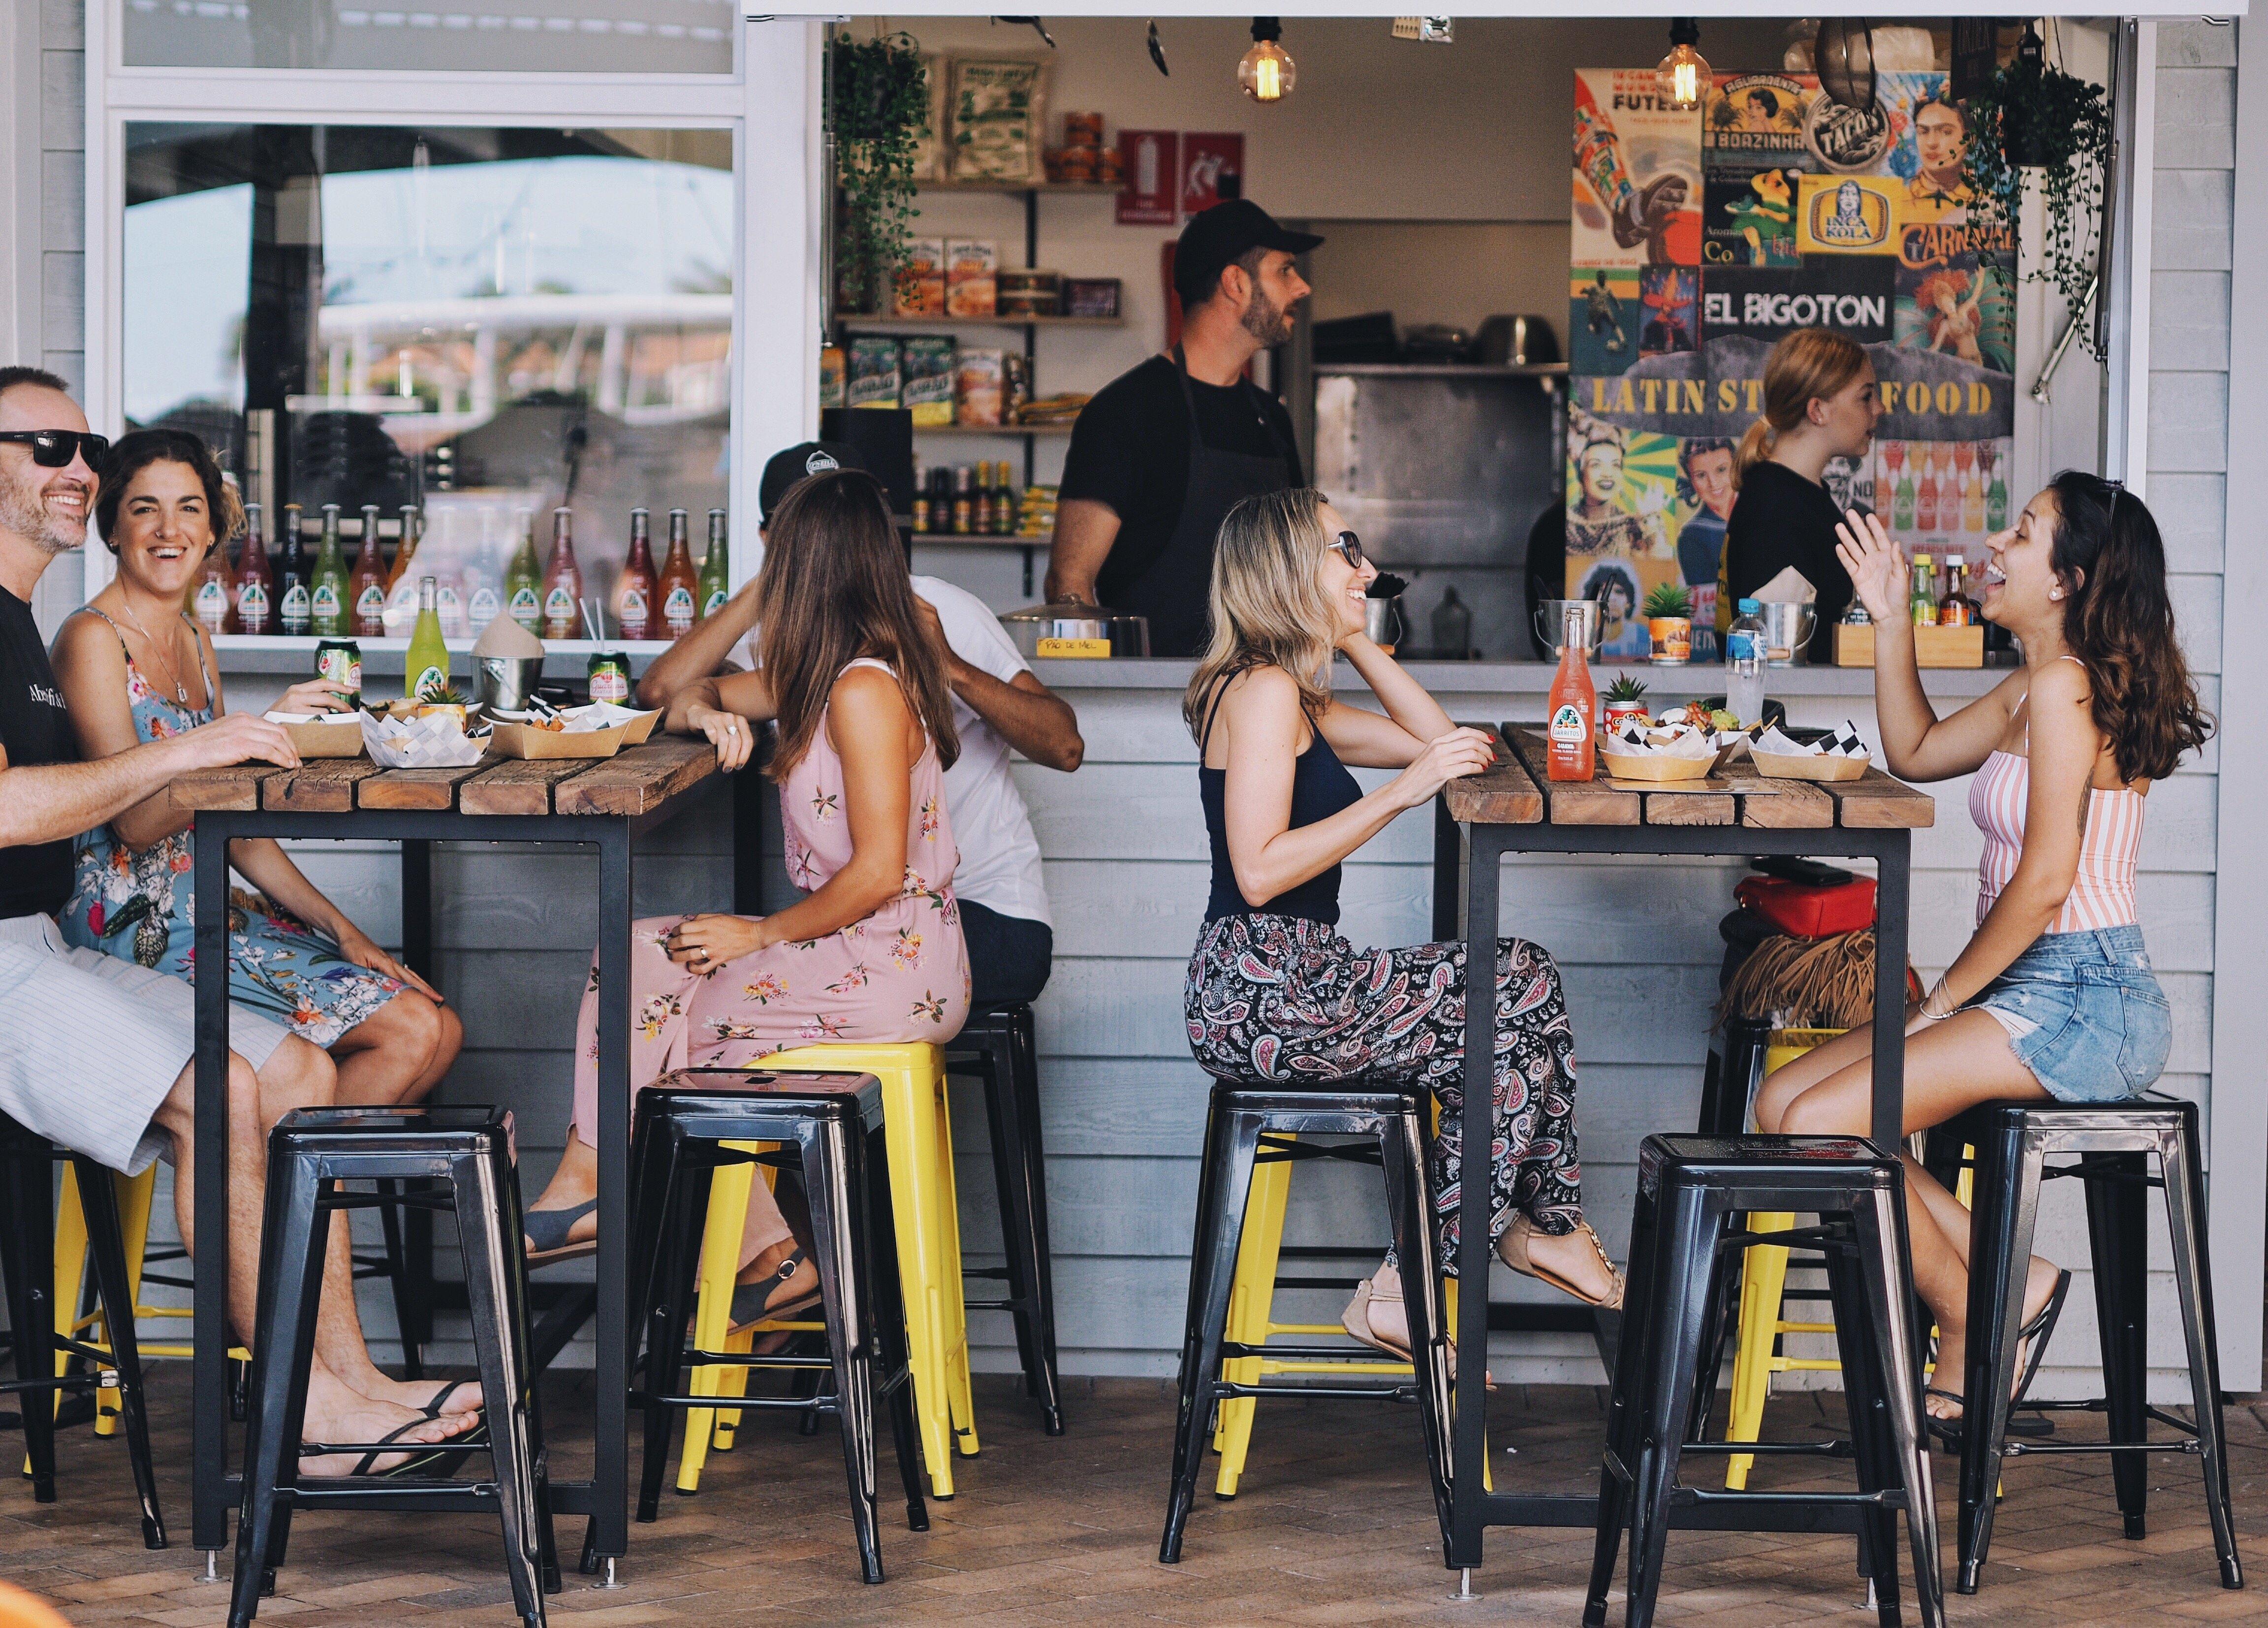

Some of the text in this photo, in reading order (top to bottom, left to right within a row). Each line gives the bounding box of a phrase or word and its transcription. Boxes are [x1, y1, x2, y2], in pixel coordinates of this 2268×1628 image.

[1826, 217, 1868, 227] INCA
[1826, 226, 1872, 239] KOLA
[1704, 293, 1885, 327] EL BIGOTON
[1592, 377, 1706, 415] LATIN
[1880, 381, 1992, 415] FOOD
[1078, 640, 1097, 649] MEL
[1554, 729, 1580, 737] JARRITOS
